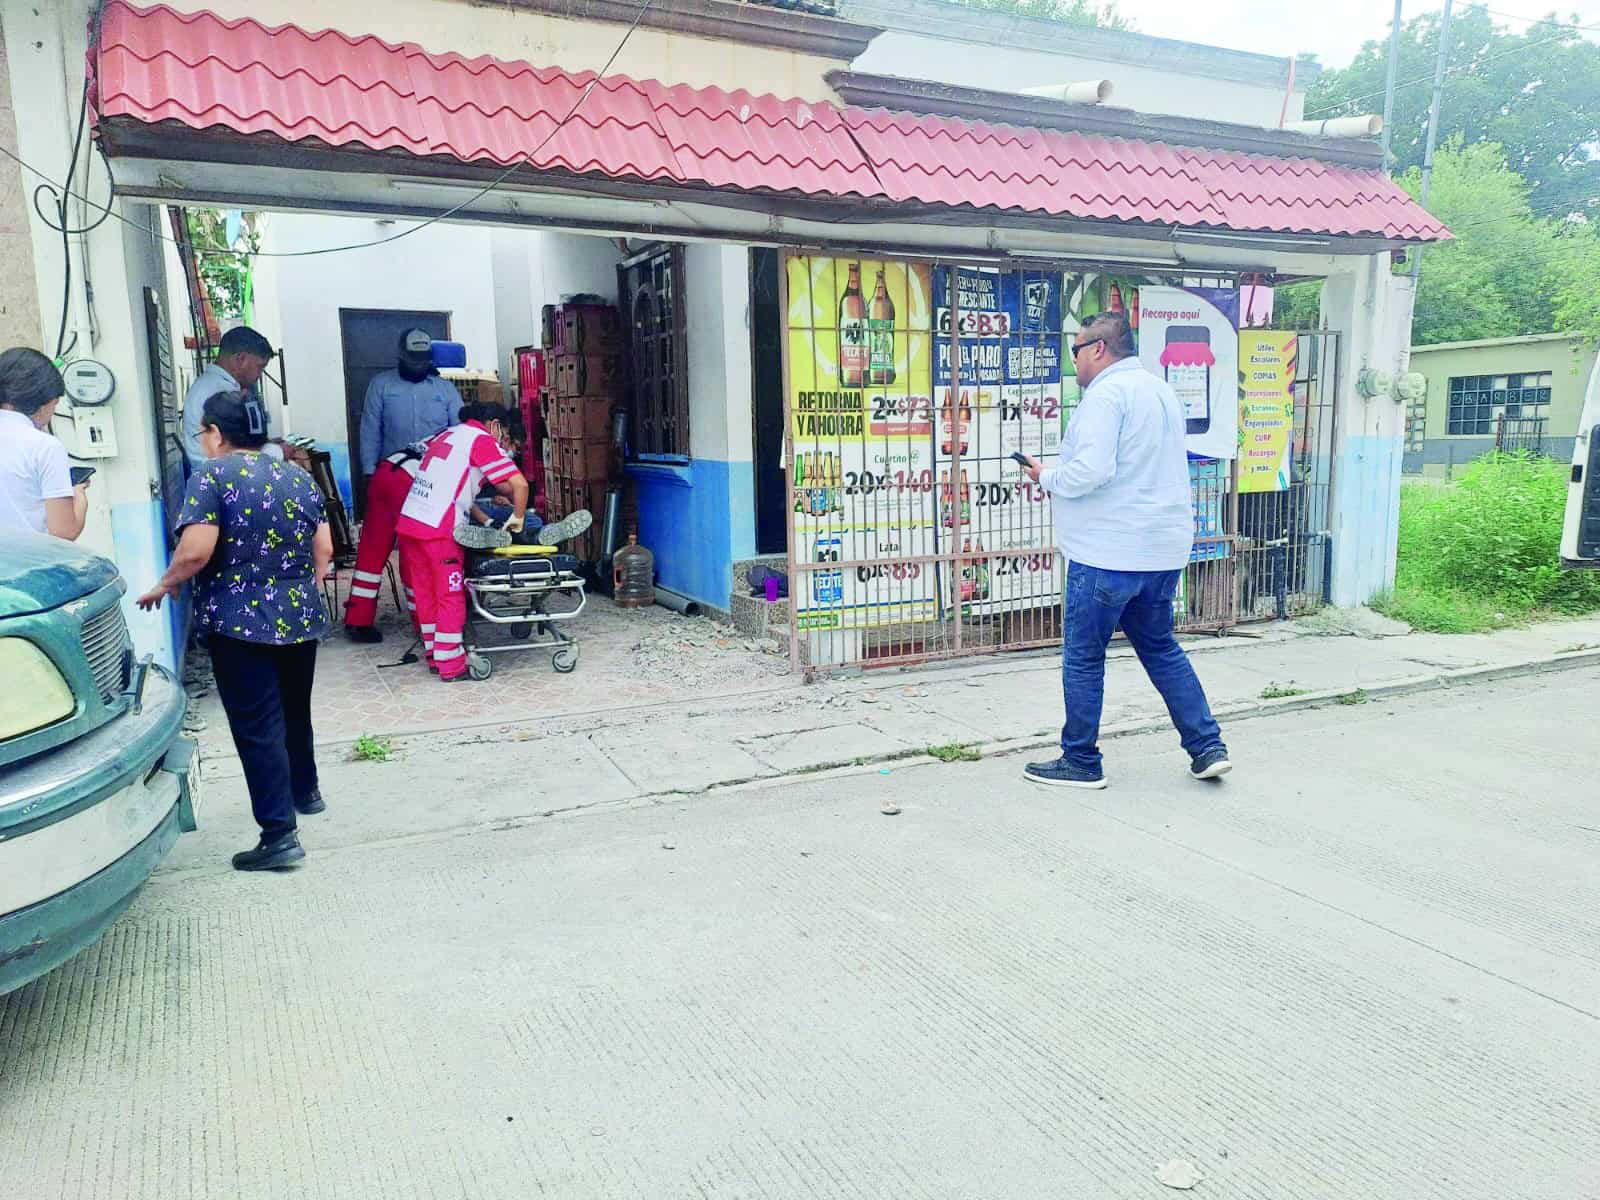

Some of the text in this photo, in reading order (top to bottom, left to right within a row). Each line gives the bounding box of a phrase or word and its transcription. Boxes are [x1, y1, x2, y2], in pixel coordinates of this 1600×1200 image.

[1142, 307, 1200, 321] Recarga aquí
[971, 345, 1001, 369] PARO
[798, 391, 863, 413] RETORNA
[1254, 432, 1272, 442] CURP
[880, 543, 900, 553] Lata
